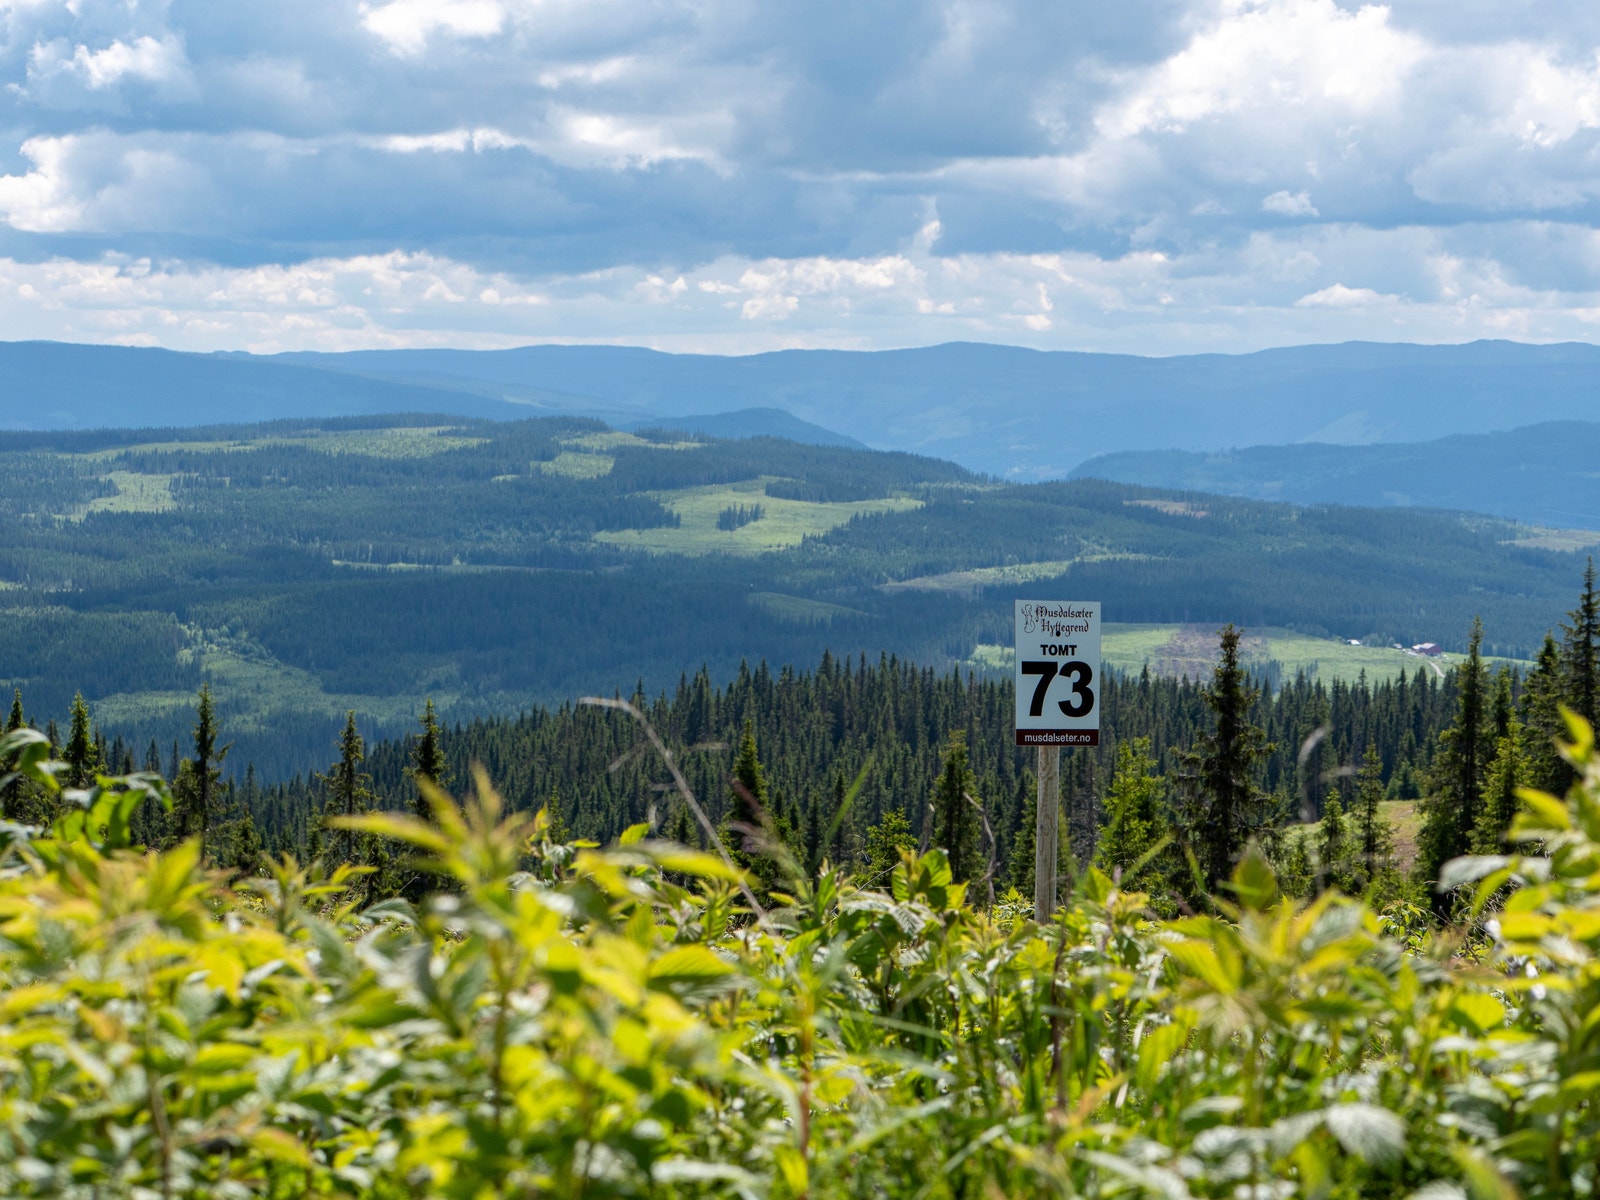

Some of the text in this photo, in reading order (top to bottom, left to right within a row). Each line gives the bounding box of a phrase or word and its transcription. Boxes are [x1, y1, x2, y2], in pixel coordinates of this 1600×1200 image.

[1035, 604, 1093, 622] Musdalsæter
[1041, 618, 1089, 637] Hyttegrend
[1040, 644, 1077, 656] TOMT
[1021, 661, 1095, 718] 73
[1024, 733, 1091, 743] musdalseter.no
